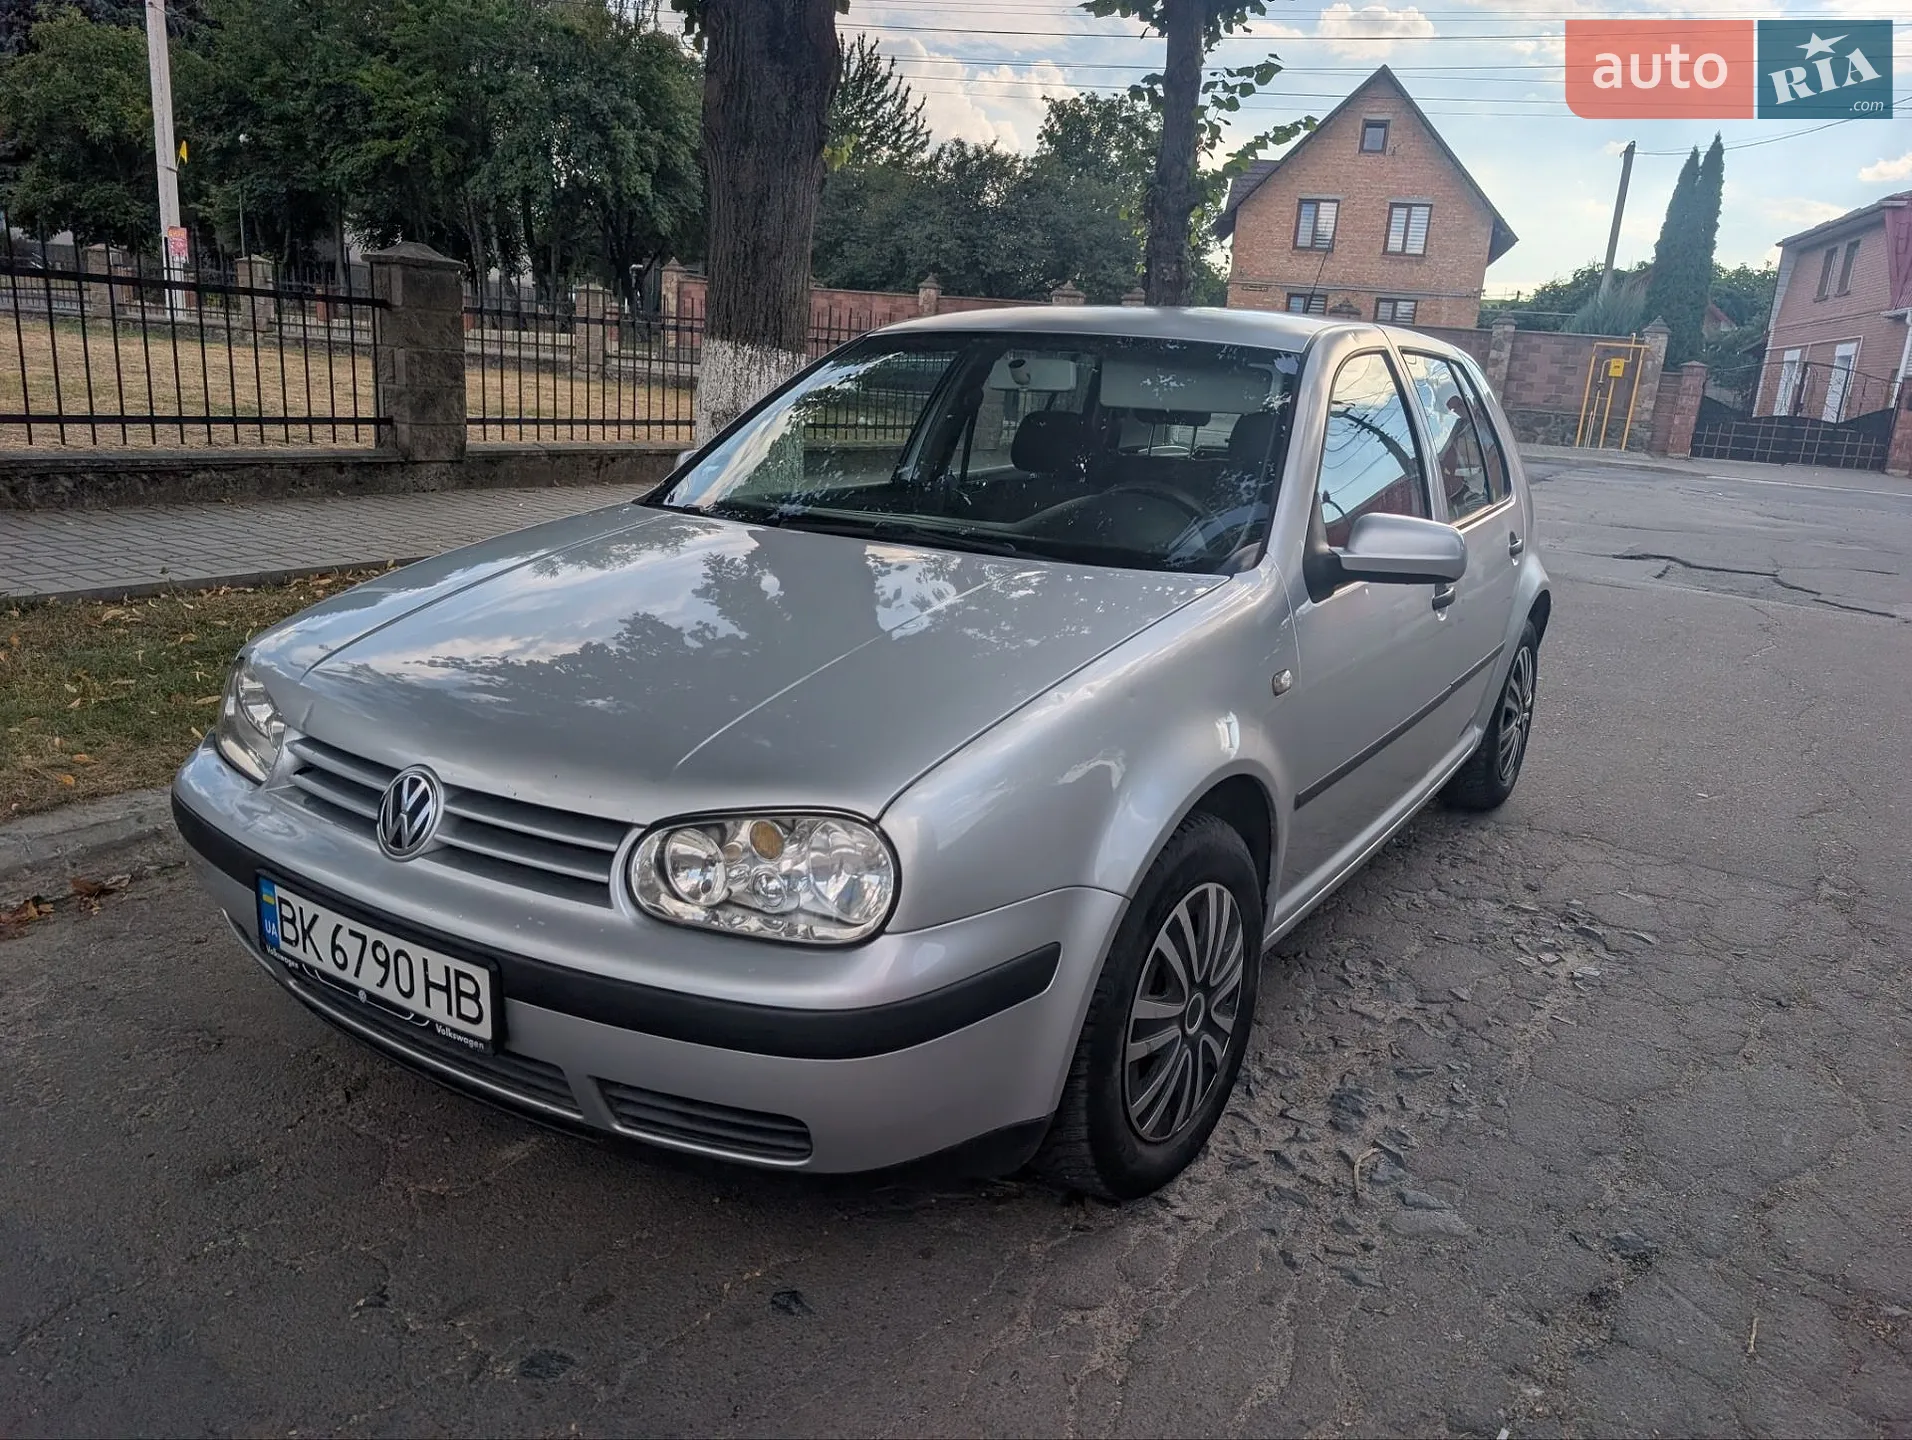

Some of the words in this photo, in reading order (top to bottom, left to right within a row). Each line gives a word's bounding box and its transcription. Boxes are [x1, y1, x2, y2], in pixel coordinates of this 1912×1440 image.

[264, 920, 278, 939] UA
[277, 895, 324, 963] BK
[330, 923, 415, 1000] 6790
[424, 957, 484, 1025] HB
[435, 1024, 485, 1051] Volkswagen
